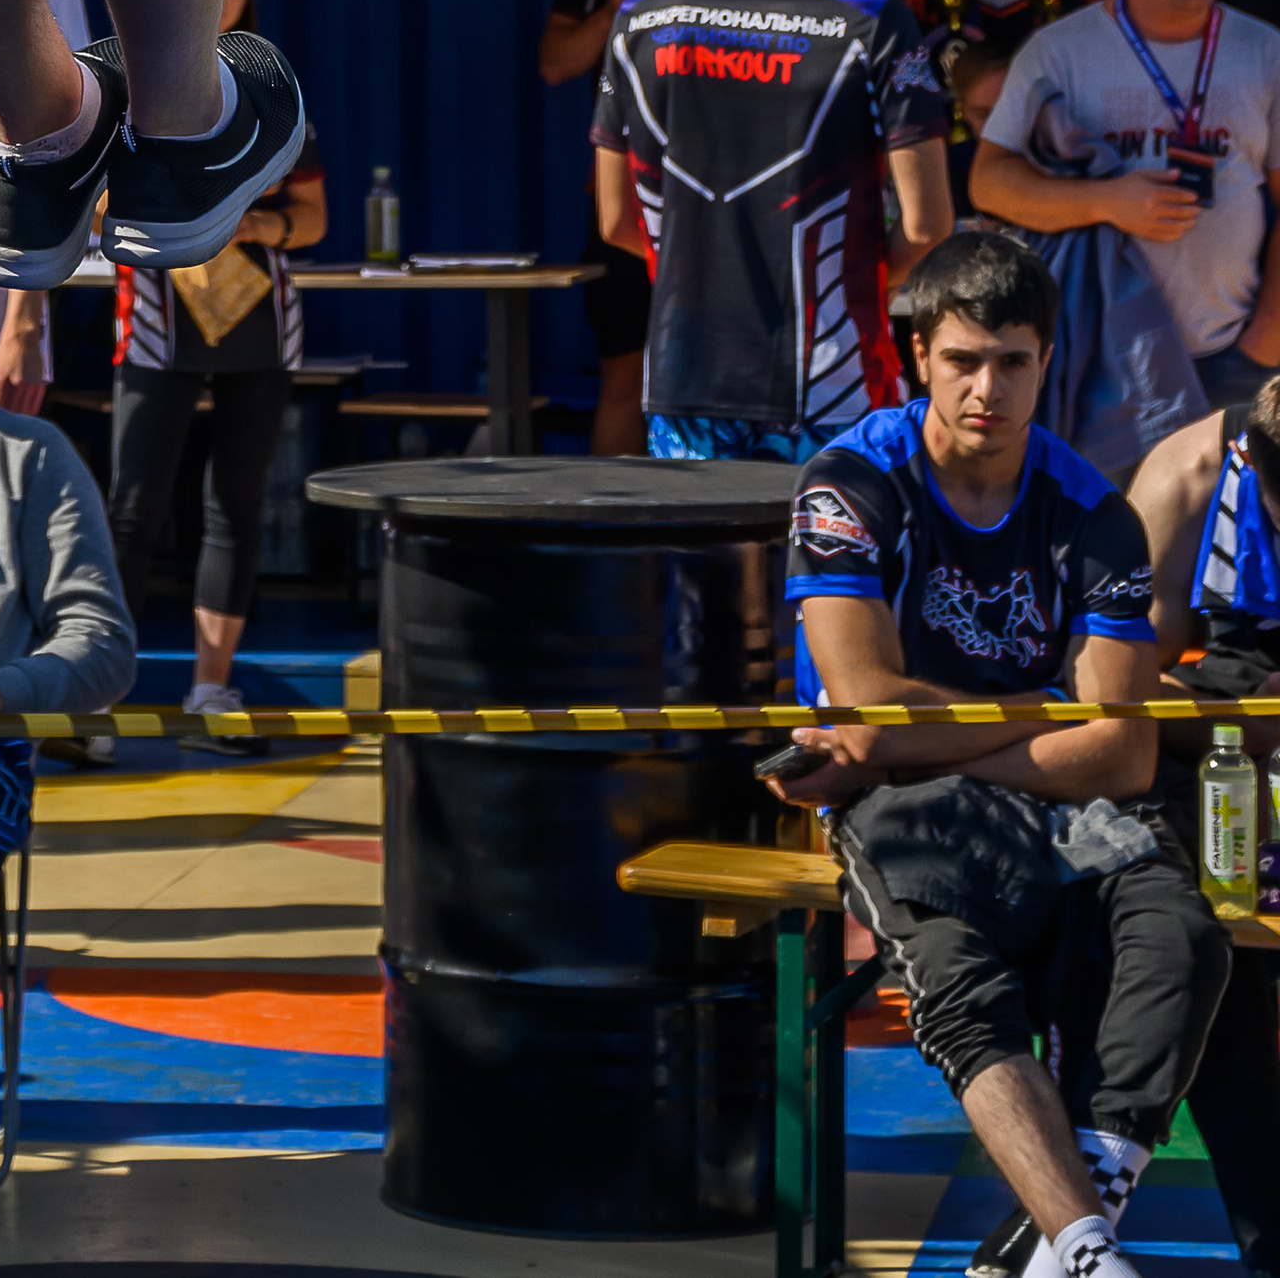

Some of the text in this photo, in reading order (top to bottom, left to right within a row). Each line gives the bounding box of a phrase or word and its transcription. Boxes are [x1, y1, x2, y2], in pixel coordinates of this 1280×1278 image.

[627, 5, 848, 38] МЕЖРЕГИОНАЛЬНЫЙ
[776, 34, 811, 53] ПО
[654, 43, 802, 85] WORKOUT
